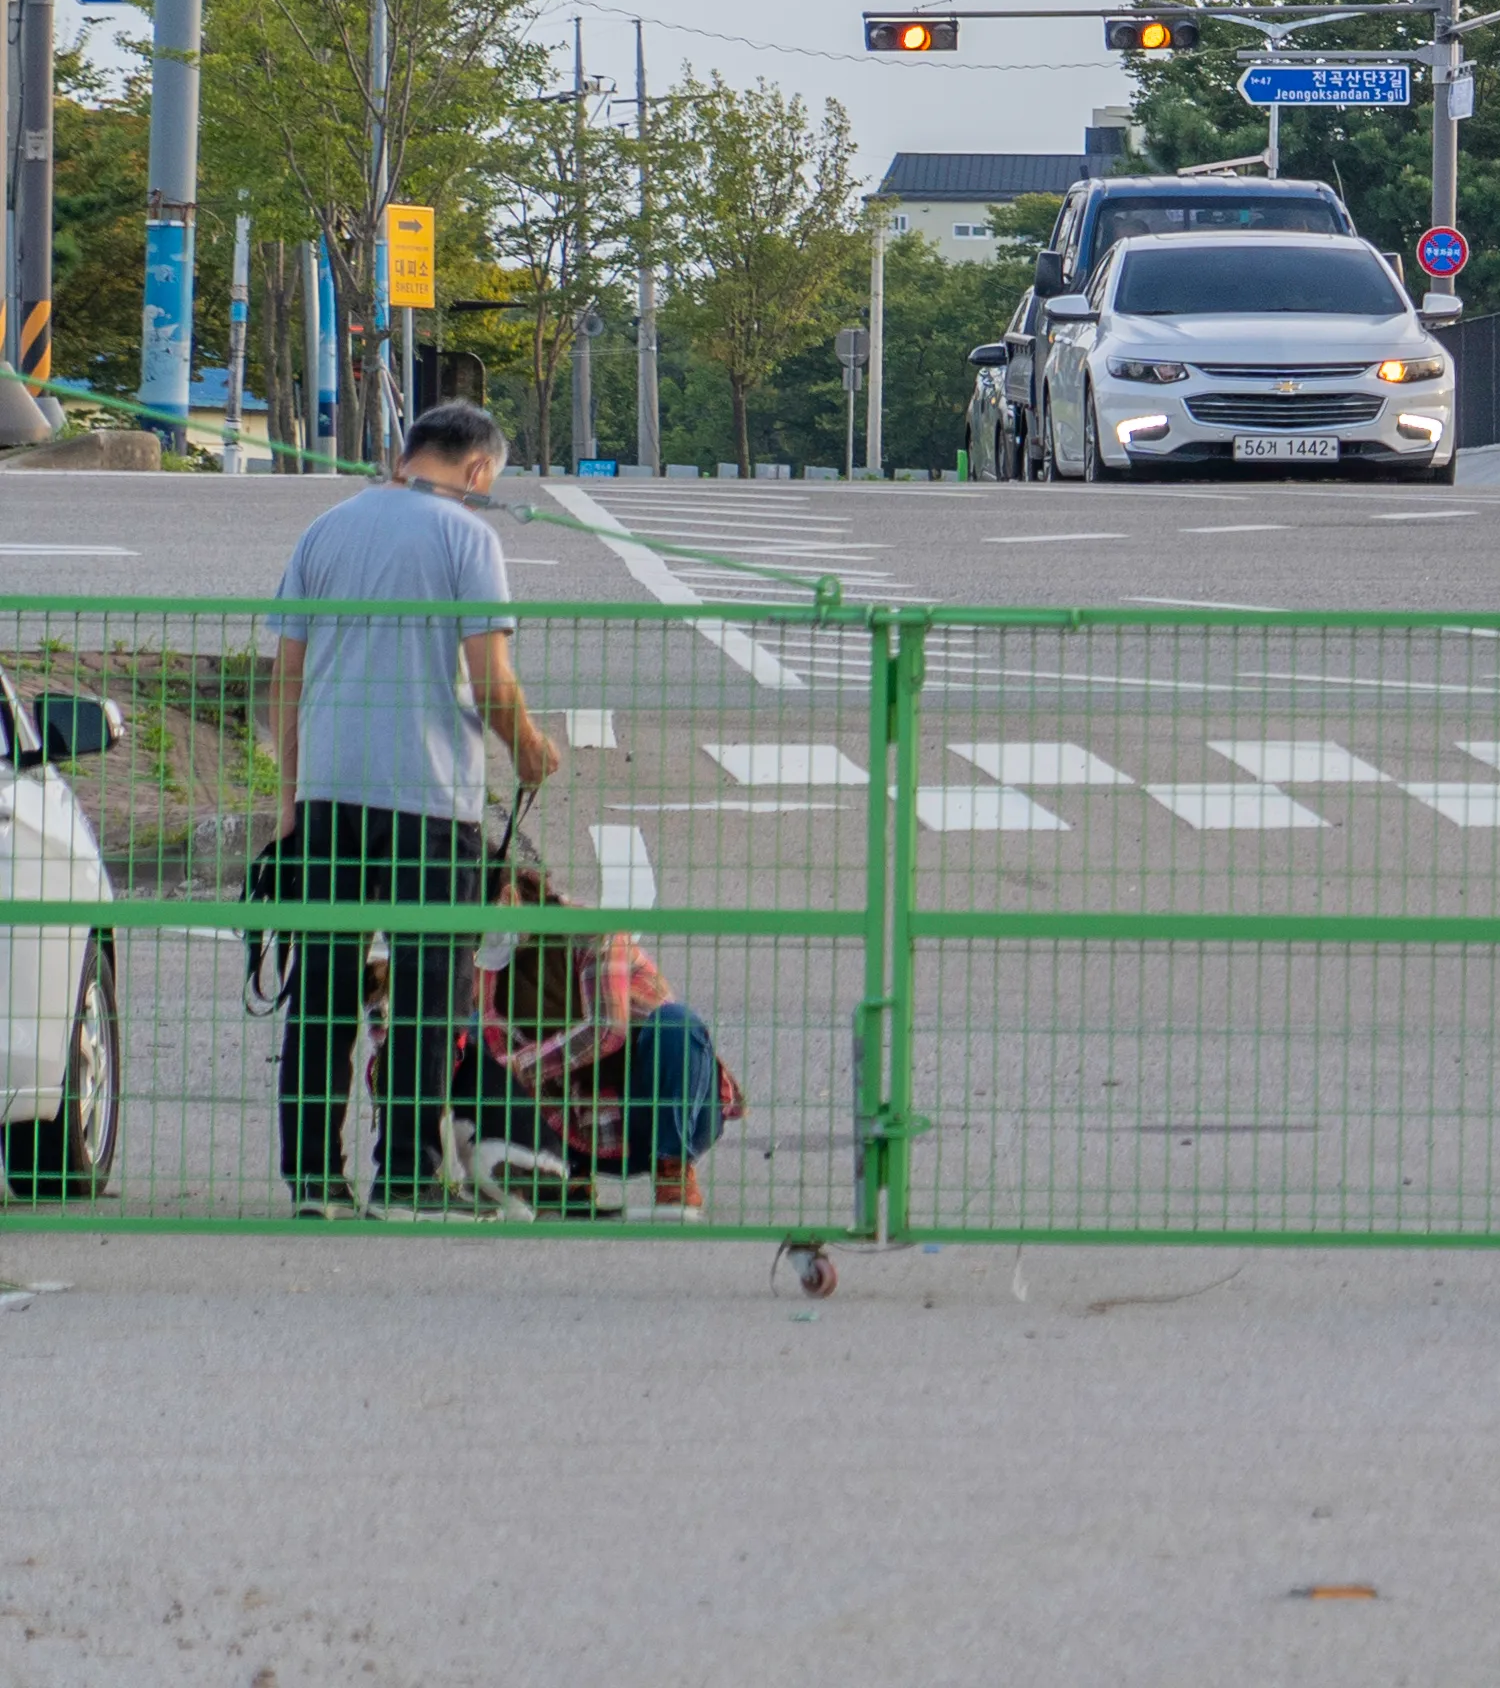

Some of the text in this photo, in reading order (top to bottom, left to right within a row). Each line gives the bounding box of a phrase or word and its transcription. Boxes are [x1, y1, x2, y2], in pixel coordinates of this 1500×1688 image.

[1312, 70, 1403, 89] 전곡산단3길
[1274, 88, 1404, 103] Jeongoksandan 3-gil
[395, 258, 429, 277] 대피소
[395, 280, 429, 295] SHELTER
[1286, 439, 1329, 456] 1442
